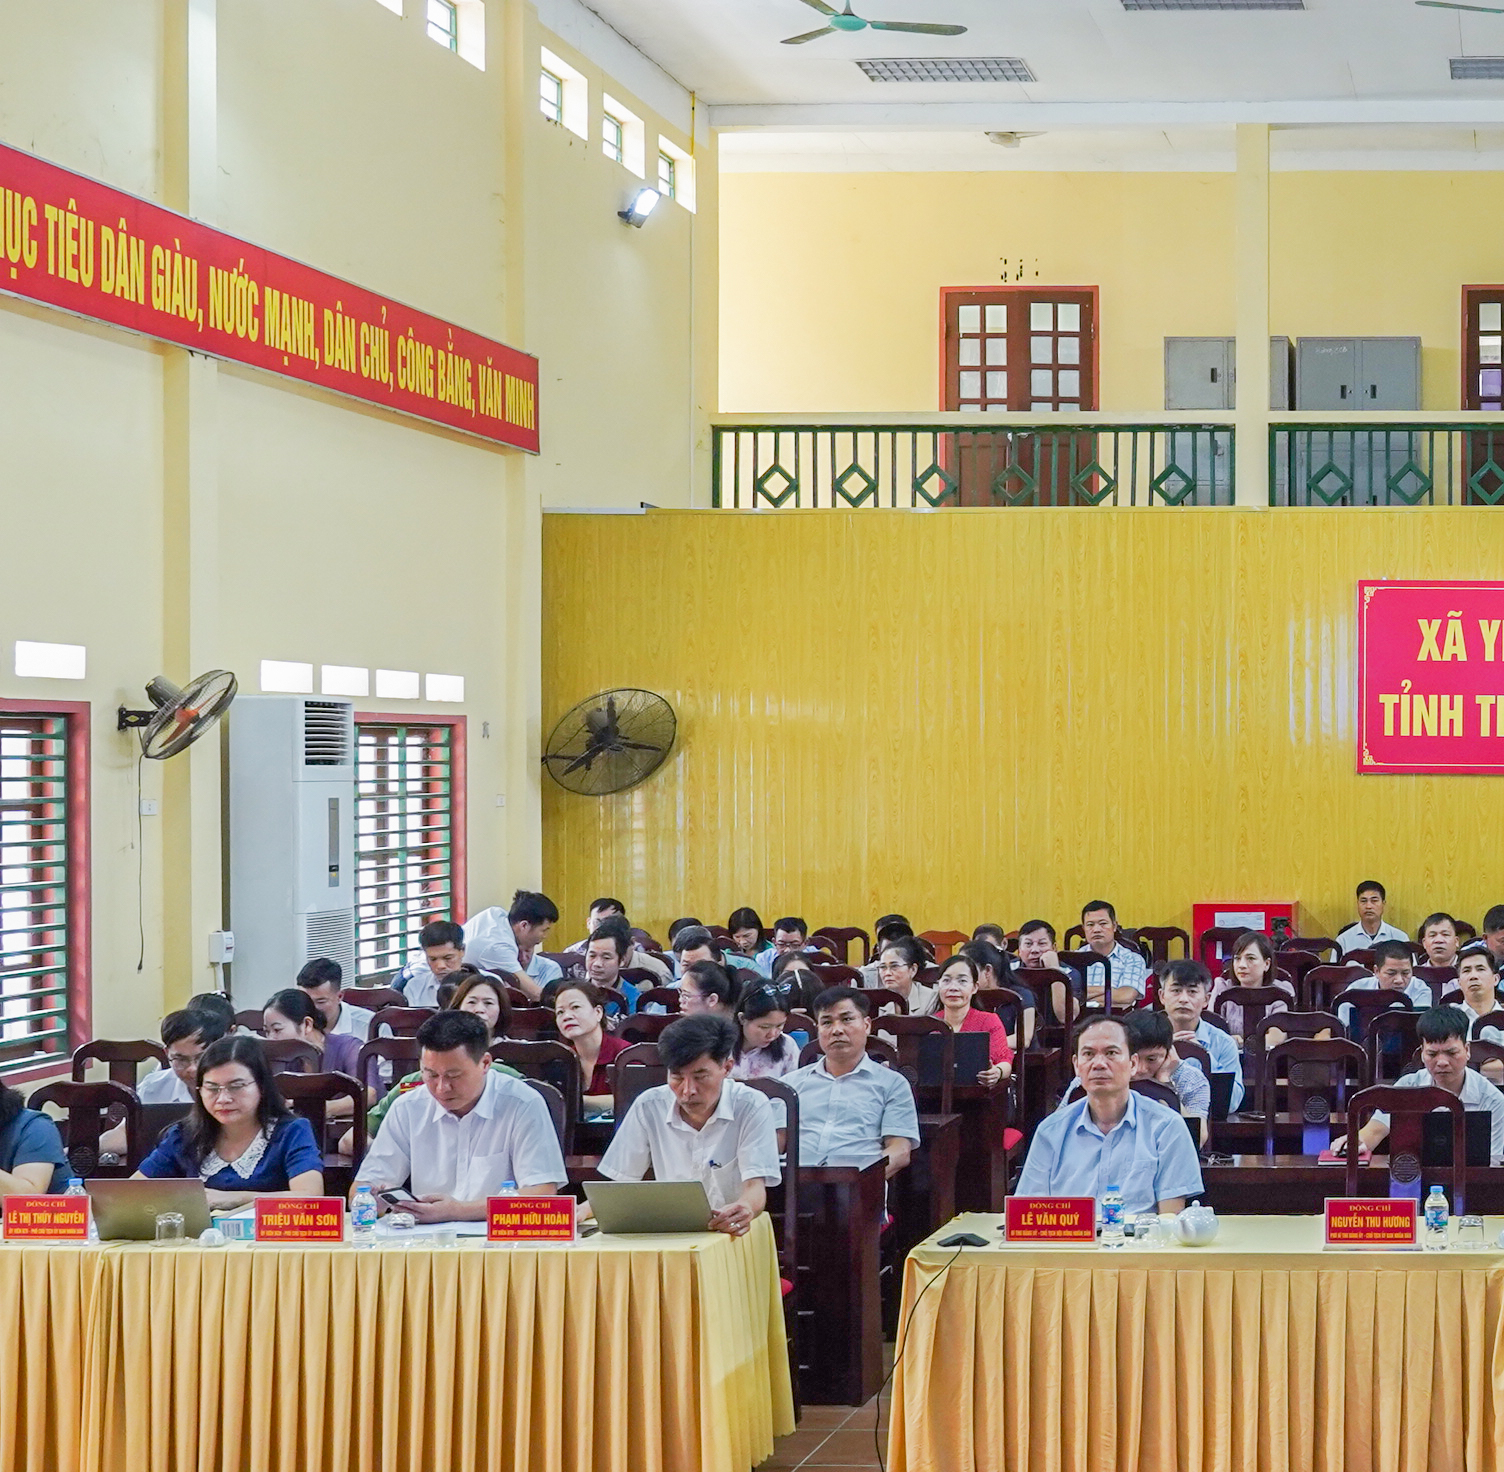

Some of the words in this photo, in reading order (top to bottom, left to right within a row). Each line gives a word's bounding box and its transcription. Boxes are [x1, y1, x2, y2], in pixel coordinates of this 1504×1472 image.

[0, 186, 37, 279] ỤC
[45, 198, 94, 288] TIÊU
[101, 218, 145, 305] DÂN
[151, 238, 203, 332] GIÀU,
[209, 258, 259, 342] NƯỚC
[265, 287, 319, 369] MẠNH,
[324, 301, 356, 373] DÂN
[360, 306, 393, 392] CHỦ,
[397, 327, 434, 399] CÔNG
[438, 328, 475, 417] BẰNG,
[478, 357, 502, 420] VĂN
[506, 374, 534, 430] MINH
[1416, 610, 1467, 661] XÃ
[1379, 679, 1463, 737] TỈNH
[9, 1210, 17, 1223] LÊ
[19, 1213, 31, 1226] THỊ
[54, 1210, 84, 1223] NGUYÊN
[262, 1213, 290, 1228] TRIỆU
[293, 1213, 313, 1225] VĂN
[316, 1214, 337, 1225] SƠN
[493, 1214, 520, 1227] PHẠM
[523, 1212, 541, 1224] HỮU
[544, 1212, 569, 1224] HOÀN
[1022, 1212, 1033, 1225] LÊ
[1036, 1212, 1056, 1225] VĂN
[1060, 1212, 1079, 1226] QUÝ
[1332, 1213, 1363, 1227] NGUYỄN
[1366, 1217, 1380, 1227] THU
[1383, 1216, 1410, 1228] HƯƠNG
